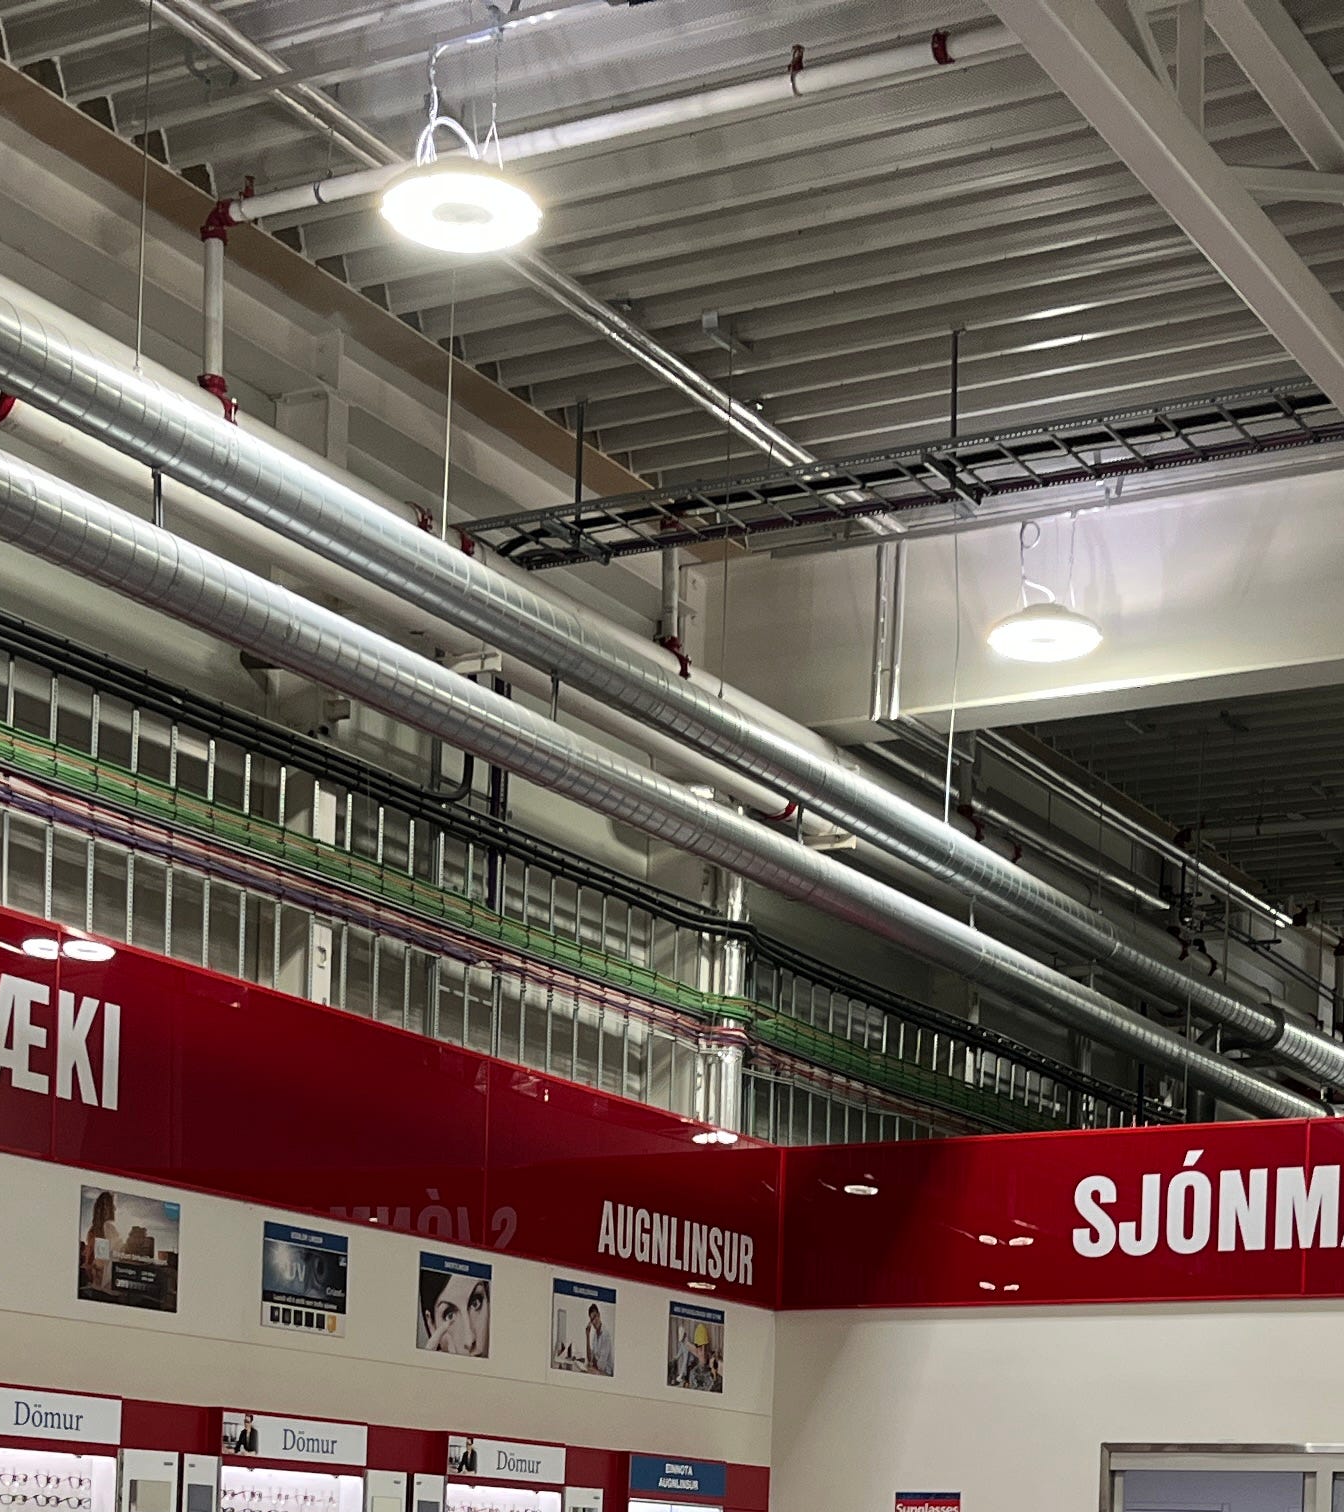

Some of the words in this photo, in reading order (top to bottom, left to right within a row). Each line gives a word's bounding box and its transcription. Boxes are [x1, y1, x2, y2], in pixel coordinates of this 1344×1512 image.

[598, 1200, 754, 1285] AUGNLINSUR
[13, 1400, 84, 1431] Dömur
[282, 1428, 338, 1454] Dömur
[495, 1450, 542, 1475] Dömur
